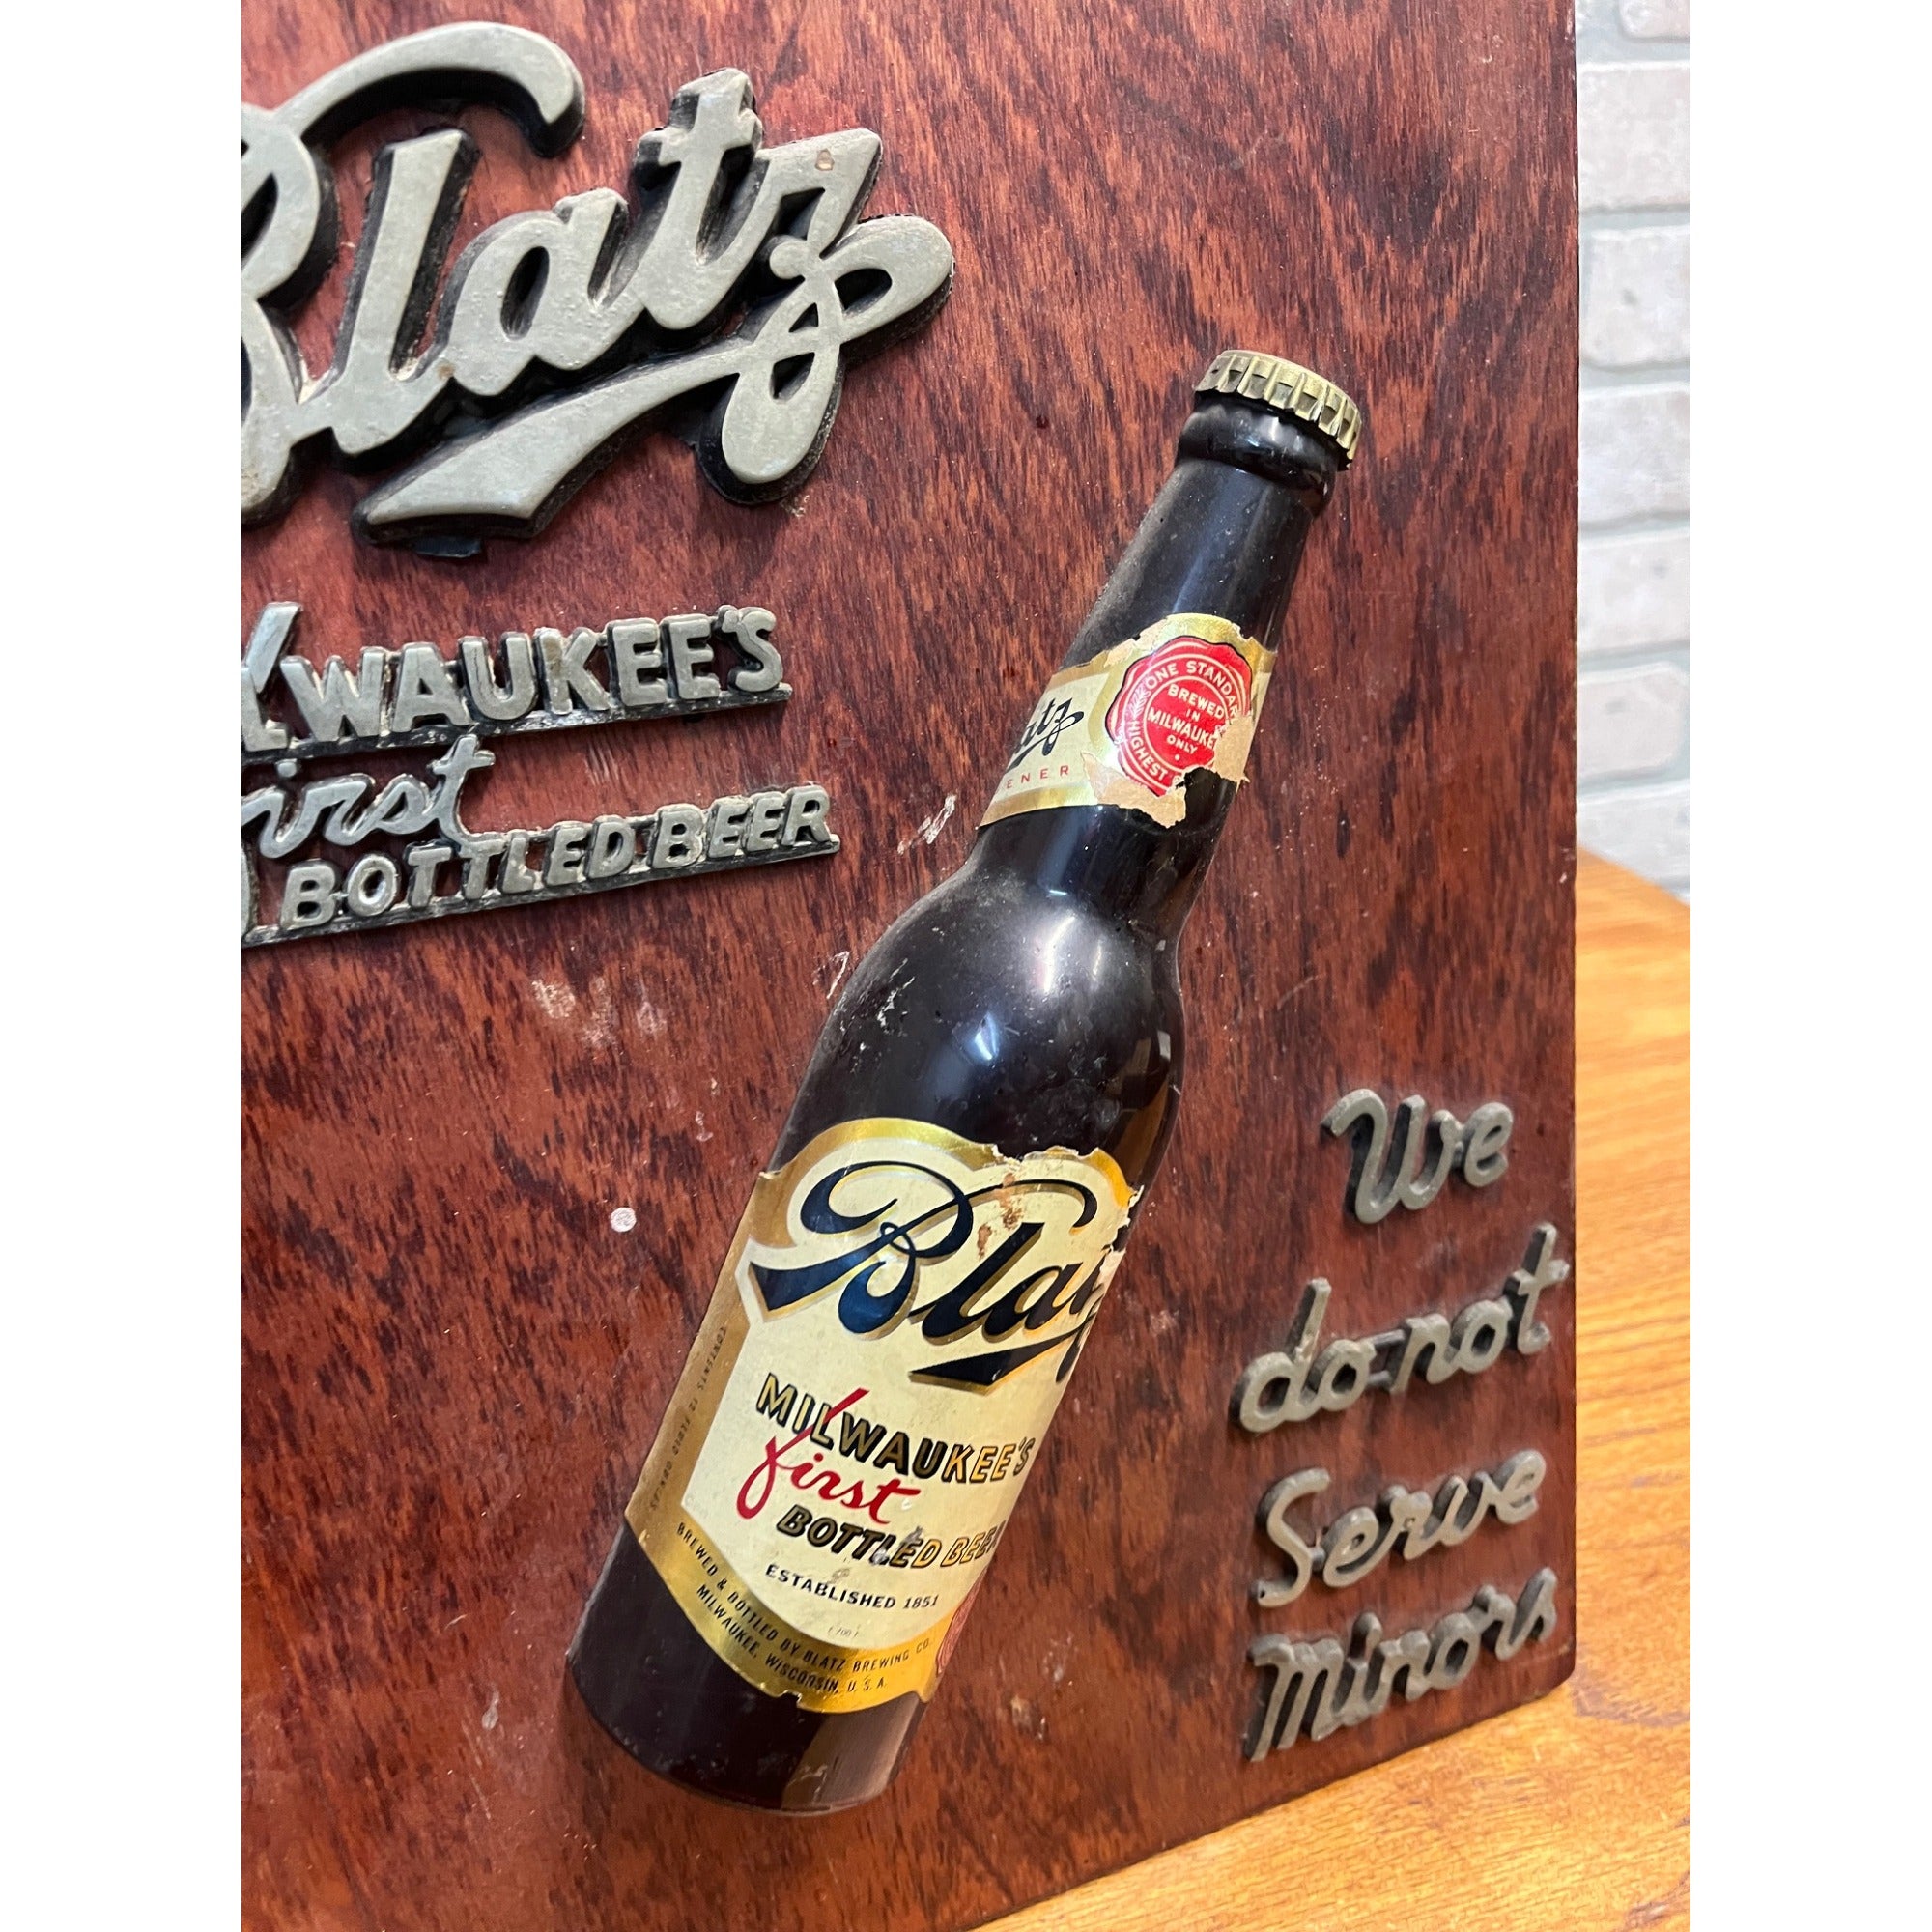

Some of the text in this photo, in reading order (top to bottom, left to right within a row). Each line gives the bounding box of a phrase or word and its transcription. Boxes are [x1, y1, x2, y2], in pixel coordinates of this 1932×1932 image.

[1145, 663, 1178, 689] ONE
[1168, 684, 1225, 720] BREWED
[1186, 709, 1201, 722] IN
[1006, 765, 1069, 789] ENER
[1128, 721, 1168, 781] HIGHEST
[1167, 734, 1198, 754] ONLY
[242, 734, 496, 858] irst
[280, 786, 831, 930] BOTTLED BEER
[1321, 1089, 1514, 1224] We
[1231, 1223, 1570, 1432] do not
[738, 1387, 921, 1524] first
[756, 1373, 1036, 1484] MILWAUKEE'S
[776, 1504, 942, 1569] BOTTLED
[1252, 1449, 1547, 1607] Serve
[677, 1522, 718, 1577] BREWED
[716, 1577, 728, 1591] &
[727, 1591, 779, 1641] BOTTLED
[780, 1638, 801, 1656] BY
[803, 1650, 846, 1673] BLATZ
[852, 1649, 909, 1673] BREWING
[765, 1564, 939, 1609] ESTABLISHED 1851
